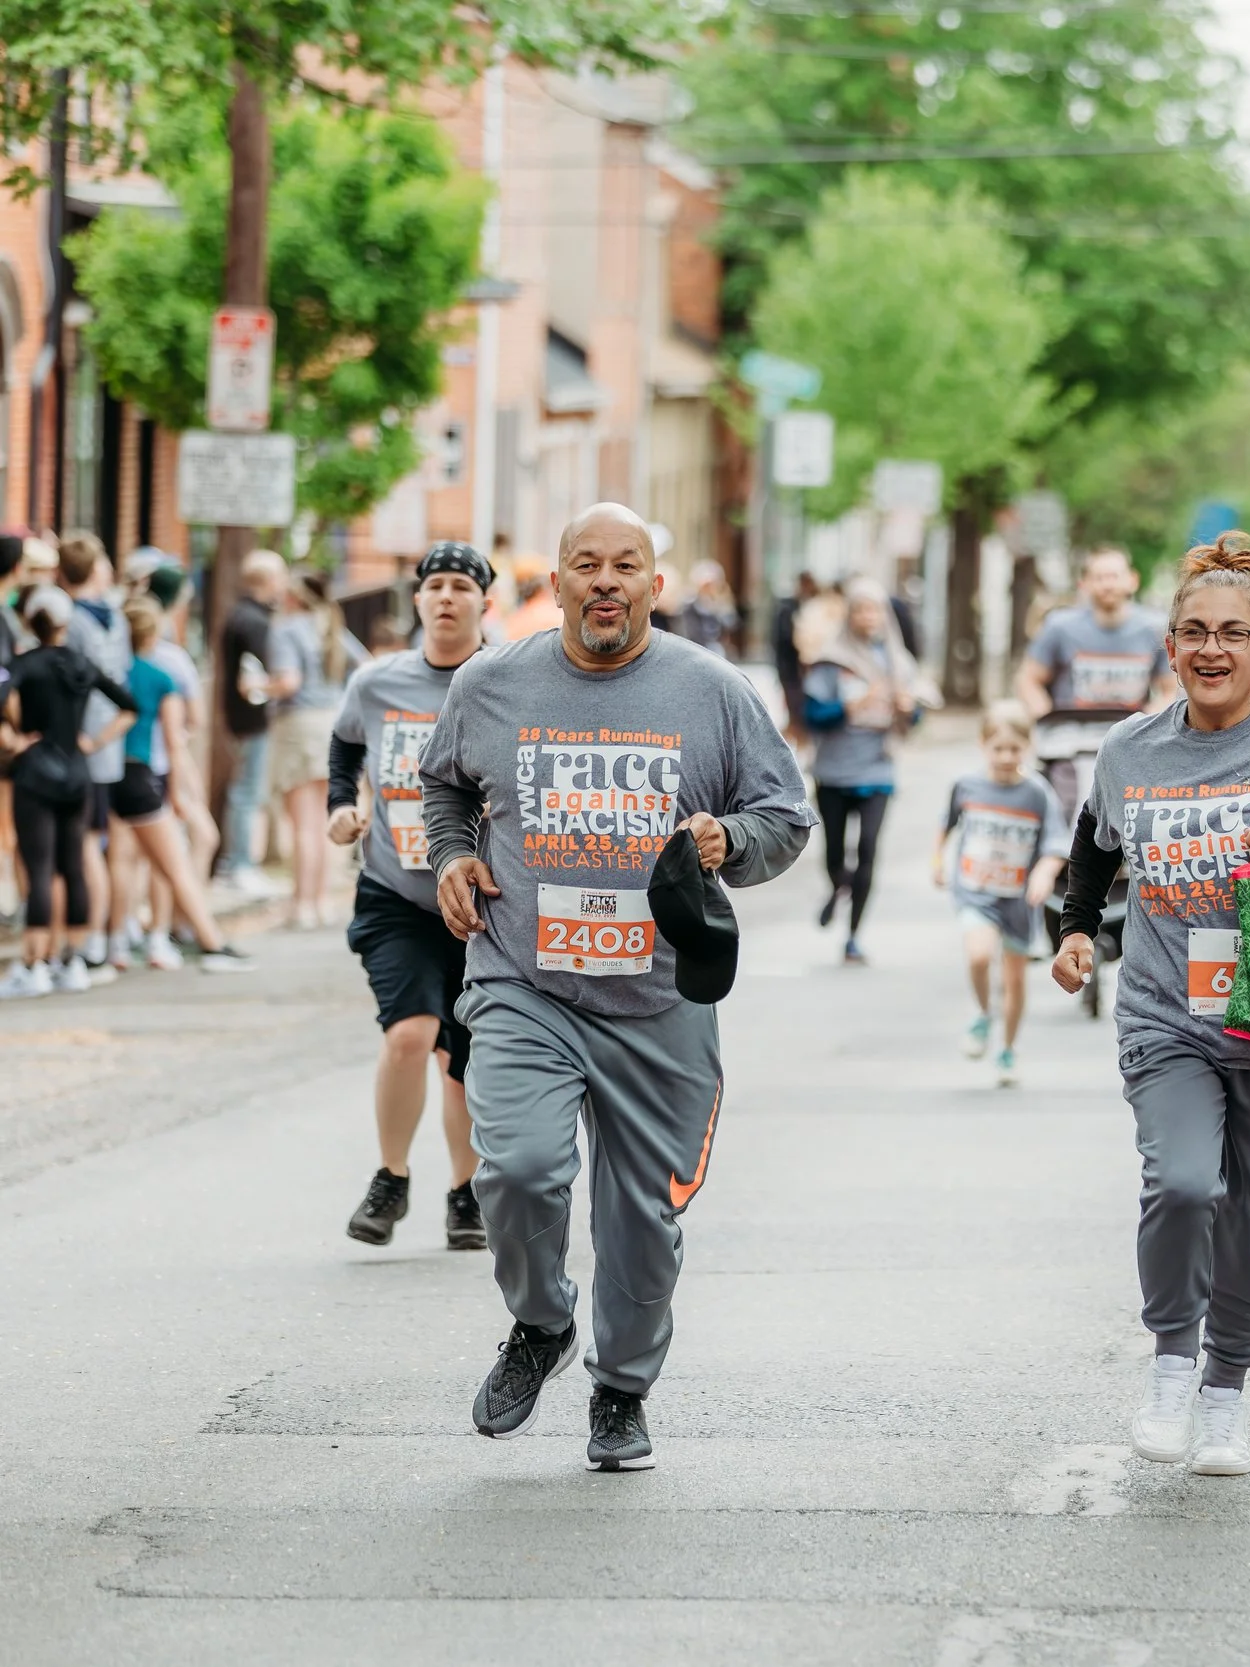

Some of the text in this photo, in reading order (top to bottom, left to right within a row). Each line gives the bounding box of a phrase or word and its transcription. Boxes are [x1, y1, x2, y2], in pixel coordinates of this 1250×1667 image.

[518, 728, 682, 750] 28 Years Running!
[541, 745, 681, 795] race
[517, 745, 542, 829] ywca
[1123, 785, 1146, 799] 28
[1149, 785, 1194, 799] Years
[546, 789, 672, 815] against
[541, 810, 676, 836] RACISM
[523, 834, 579, 850] APRIL
[584, 834, 619, 854] 25,
[1123, 802, 1150, 881] ywca
[1147, 833, 1249, 866] agains
[523, 851, 649, 872] LANCASTER,
[1145, 850, 1250, 887] RACIS
[1139, 884, 1187, 902] APRIL
[1189, 880, 1223, 899] 25,
[1141, 894, 1235, 919] LANCASTE
[546, 922, 646, 954] 2408
